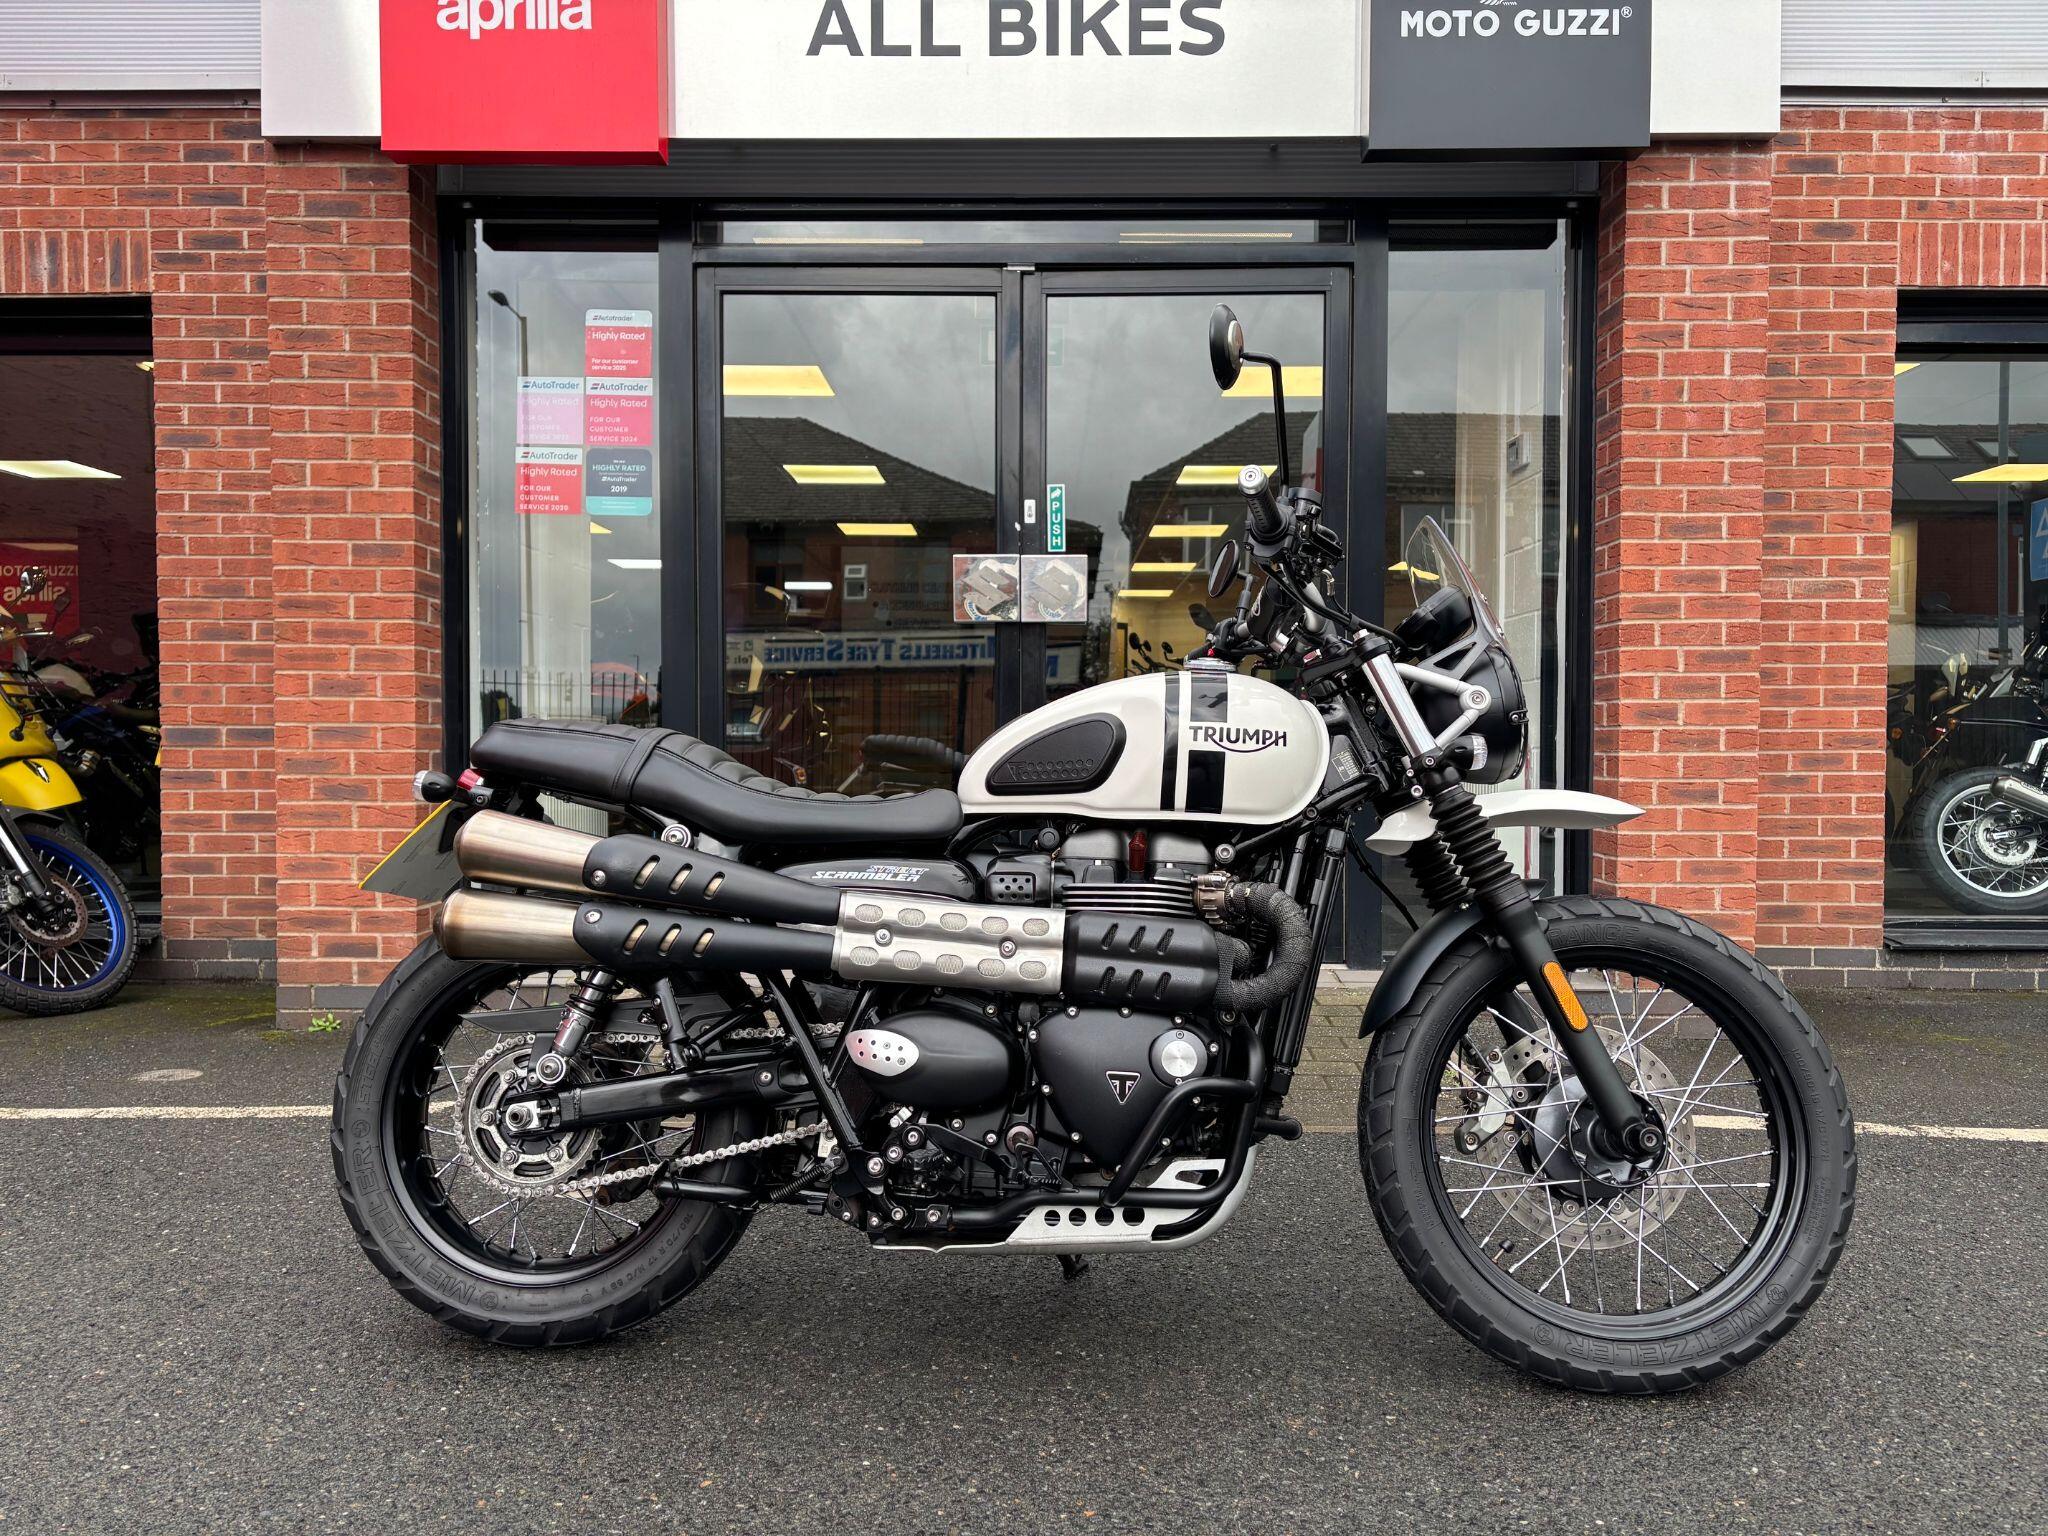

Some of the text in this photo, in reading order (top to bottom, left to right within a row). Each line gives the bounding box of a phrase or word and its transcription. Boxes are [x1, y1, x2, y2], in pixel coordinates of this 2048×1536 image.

[436, 0, 592, 39] aprilia
[1400, 9, 1500, 37] MOTO
[806, 0, 1226, 56] ALL BIKES
[591, 331, 645, 341] Highly Rated
[531, 380, 580, 390] AutoTrader
[599, 382, 649, 392] AutoTrader
[590, 398, 648, 409] Highly Rated
[530, 451, 578, 460] AutoTrader
[520, 466, 577, 477] Highly Rated
[592, 464, 620, 472] HIGHLY
[610, 485, 628, 493] 2019
[520, 503, 549, 511] SERVICE
[1052, 501, 1061, 546] PUSH
[1188, 726, 1287, 752] TRIUMPH
[812, 870, 921, 882] SCRAMBLER
[1565, 1302, 1769, 1367] METZELER
